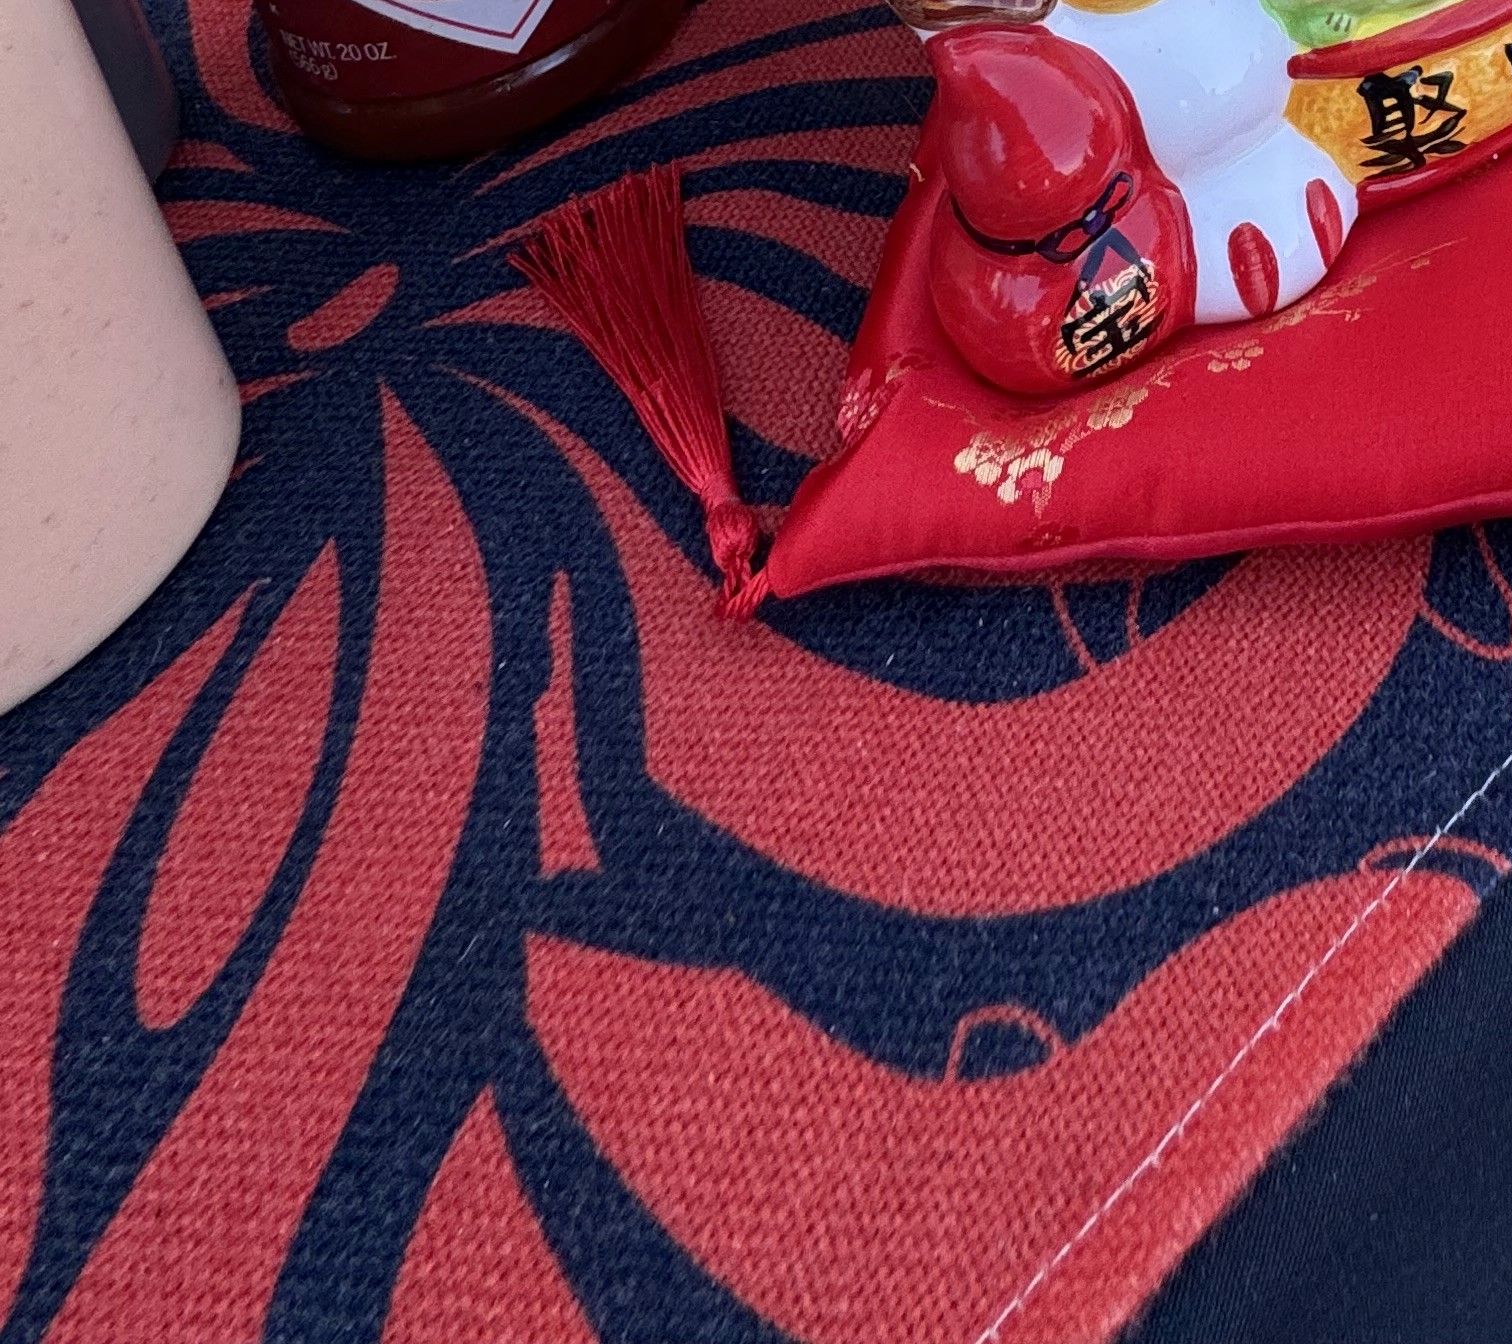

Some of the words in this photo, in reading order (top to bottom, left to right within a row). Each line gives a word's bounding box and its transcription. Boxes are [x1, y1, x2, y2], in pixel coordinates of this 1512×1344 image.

[279, 29, 305, 53] NET
[306, 38, 336, 59] WT.
[336, 43, 362, 61] 20
[364, 41, 397, 60] OZ.
